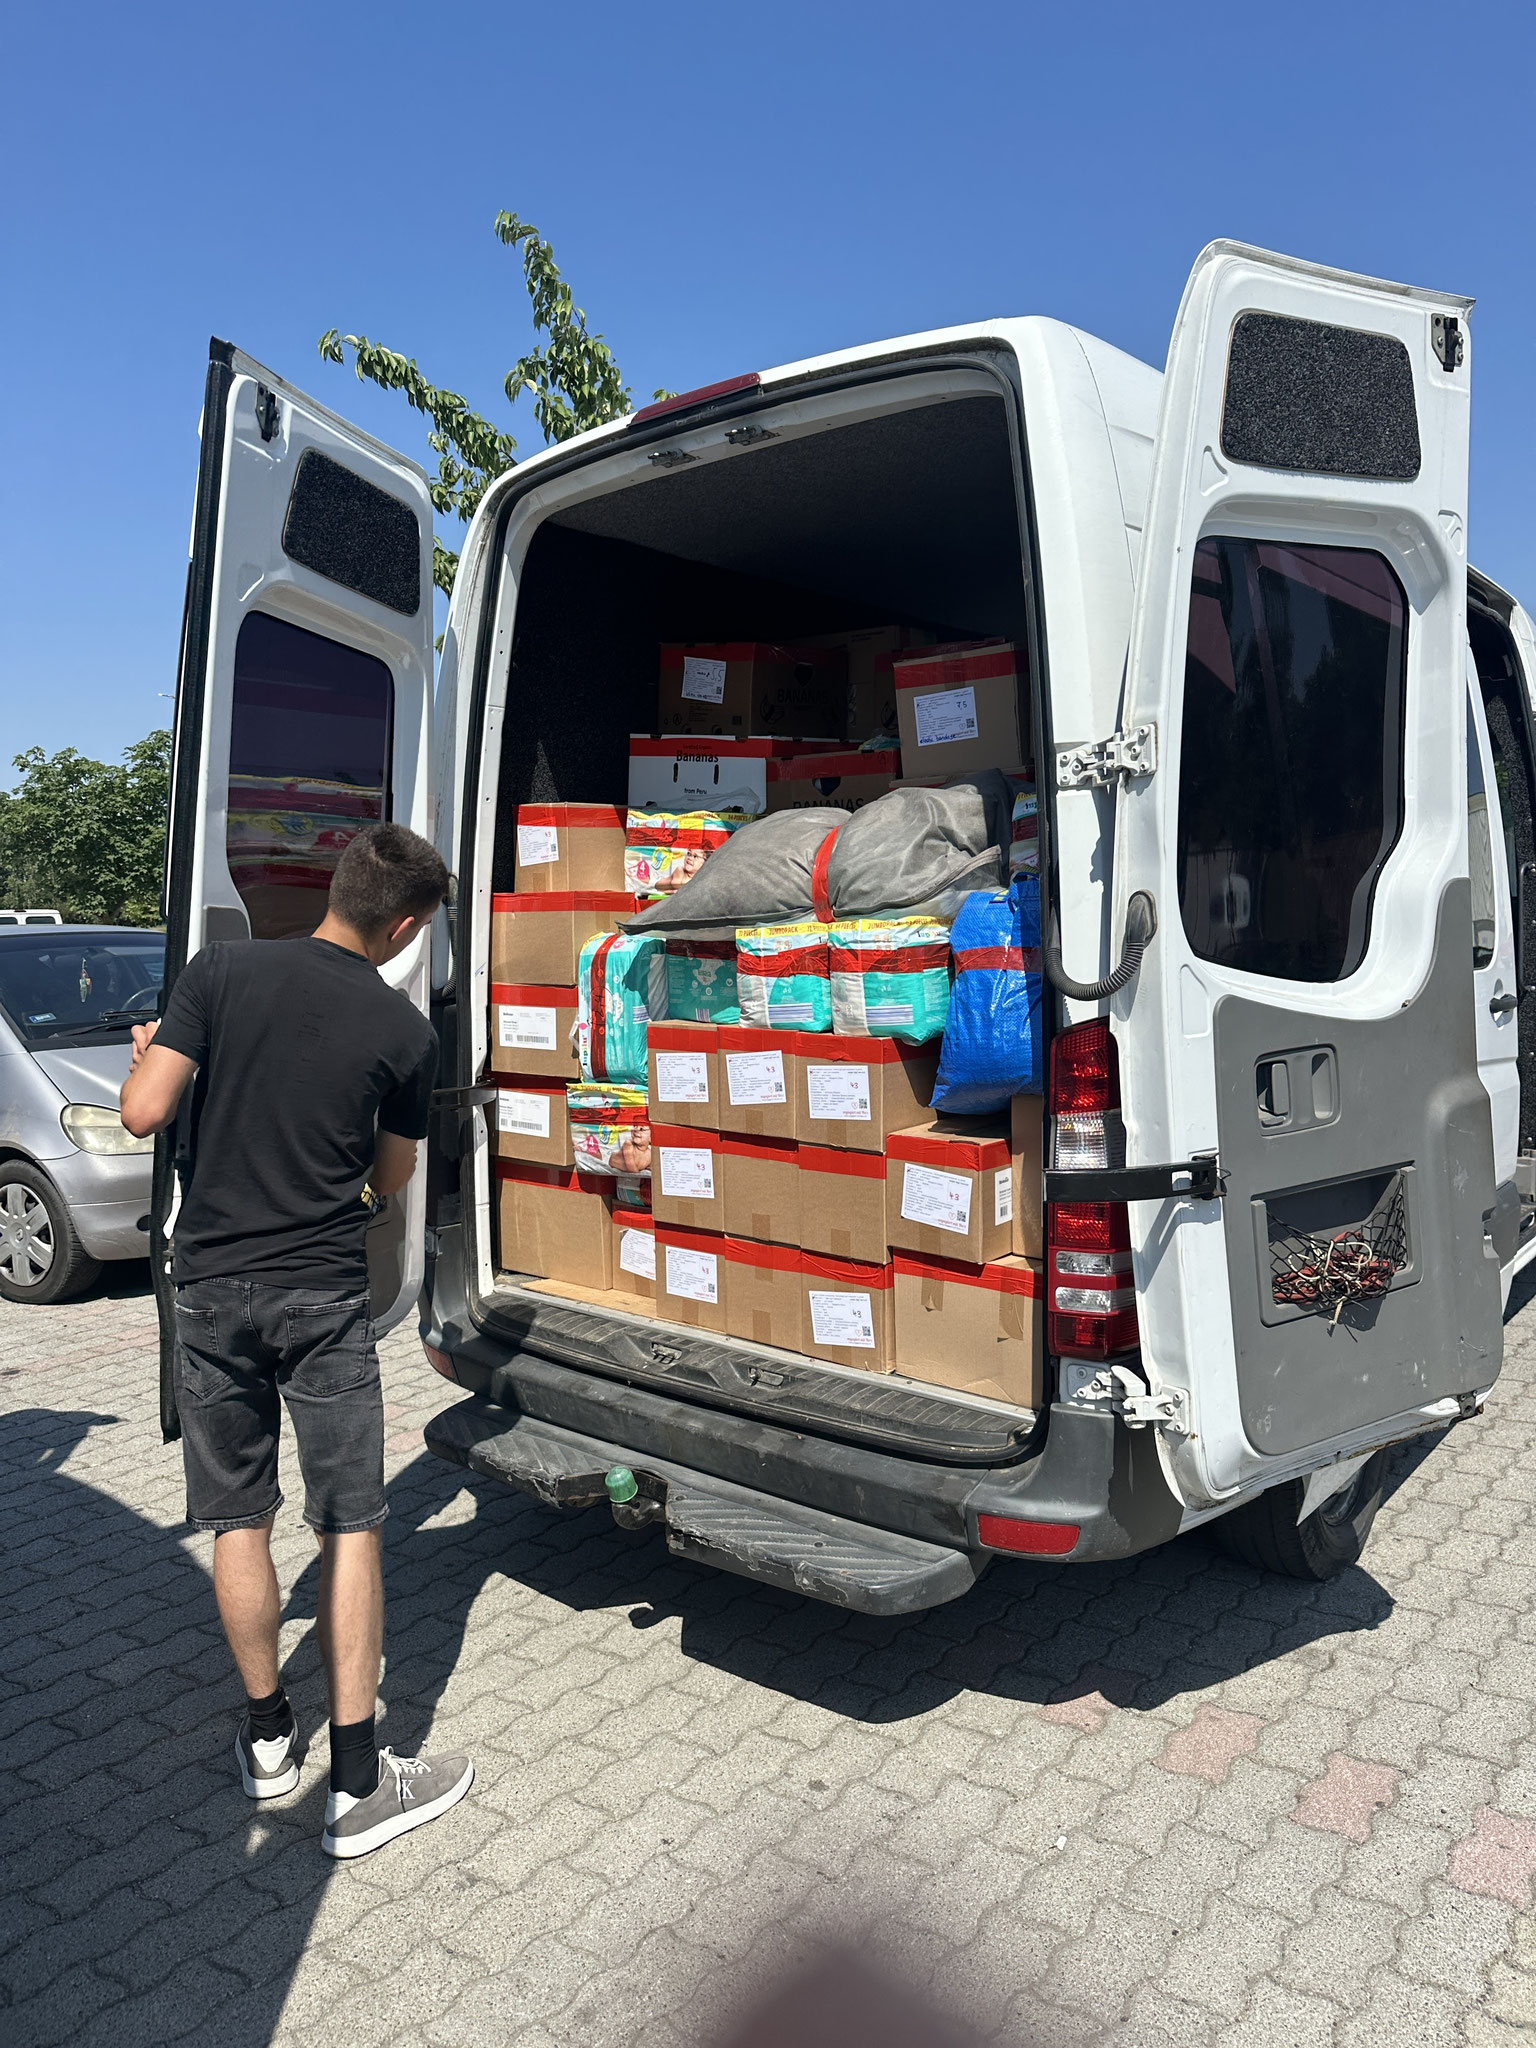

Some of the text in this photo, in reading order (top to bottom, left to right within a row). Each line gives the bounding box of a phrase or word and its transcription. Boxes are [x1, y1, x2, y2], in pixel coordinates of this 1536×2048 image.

[676, 750, 719, 763] Bananas
[640, 861, 646, 872] 4
[588, 1136, 594, 1147] 4
[949, 1192, 960, 1201] 43
[852, 1309, 862, 1319] 43
[401, 1779, 416, 1800] K
